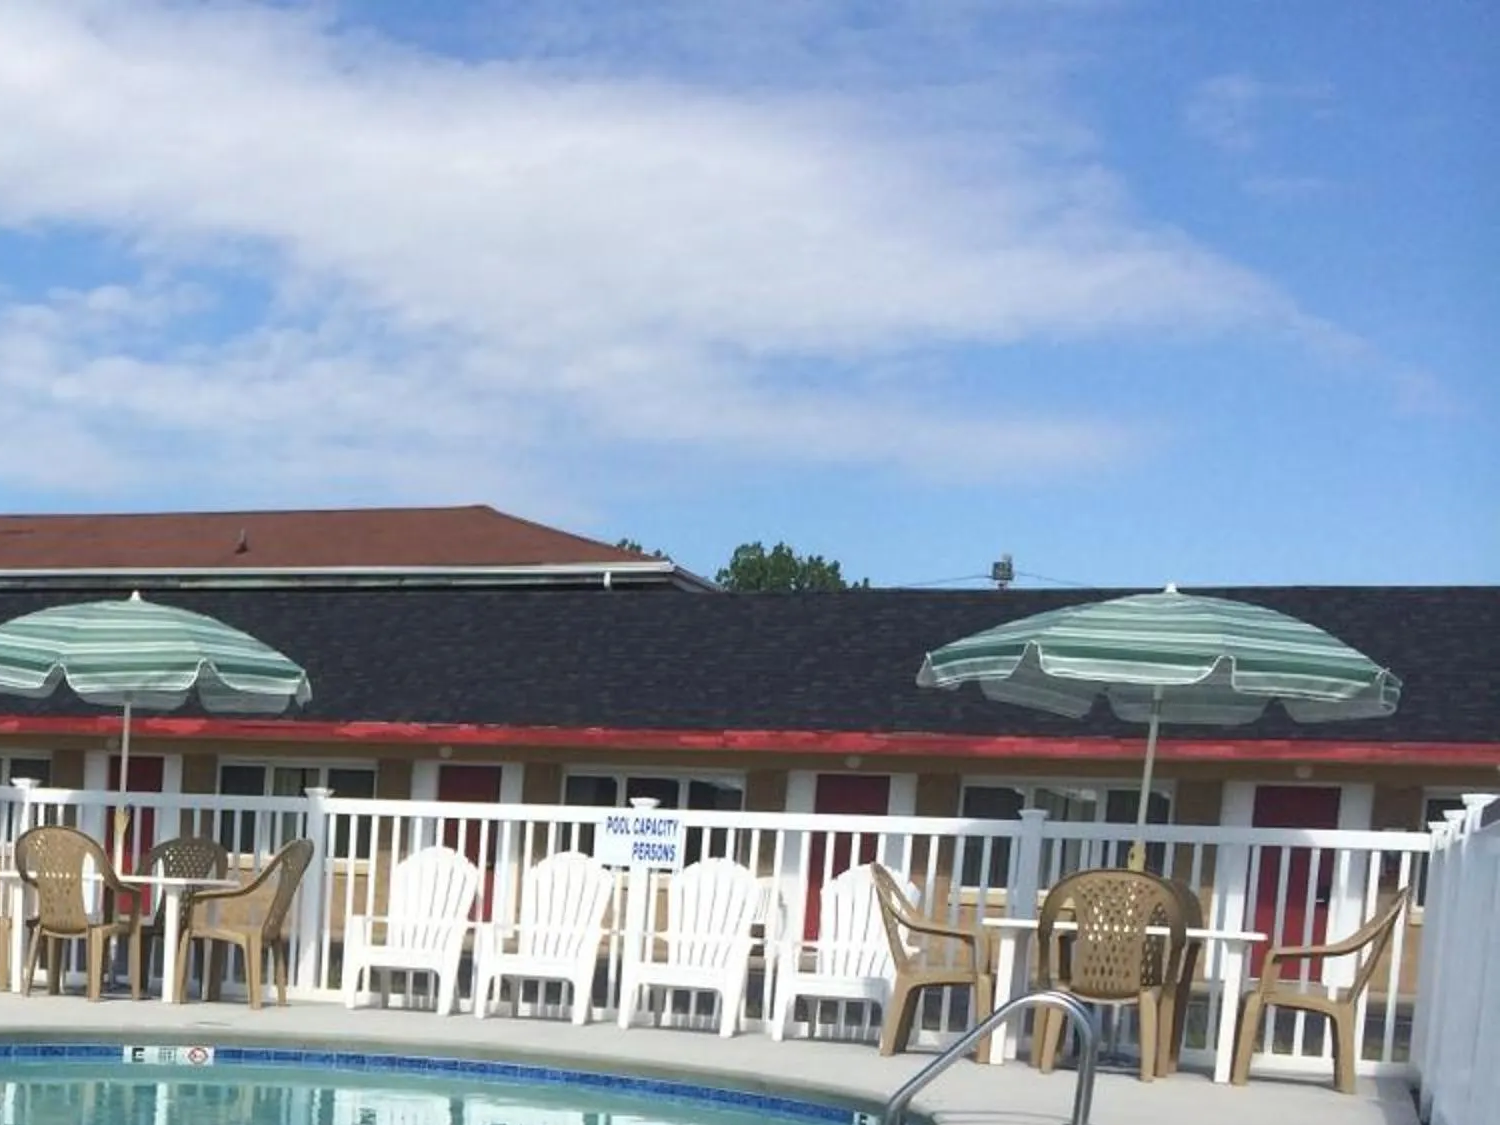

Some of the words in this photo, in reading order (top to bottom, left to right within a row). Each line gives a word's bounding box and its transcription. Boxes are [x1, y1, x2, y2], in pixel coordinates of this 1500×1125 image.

[605, 815, 631, 834] POOL
[633, 816, 679, 837] CAPACITY
[632, 840, 676, 862] PERSONS
